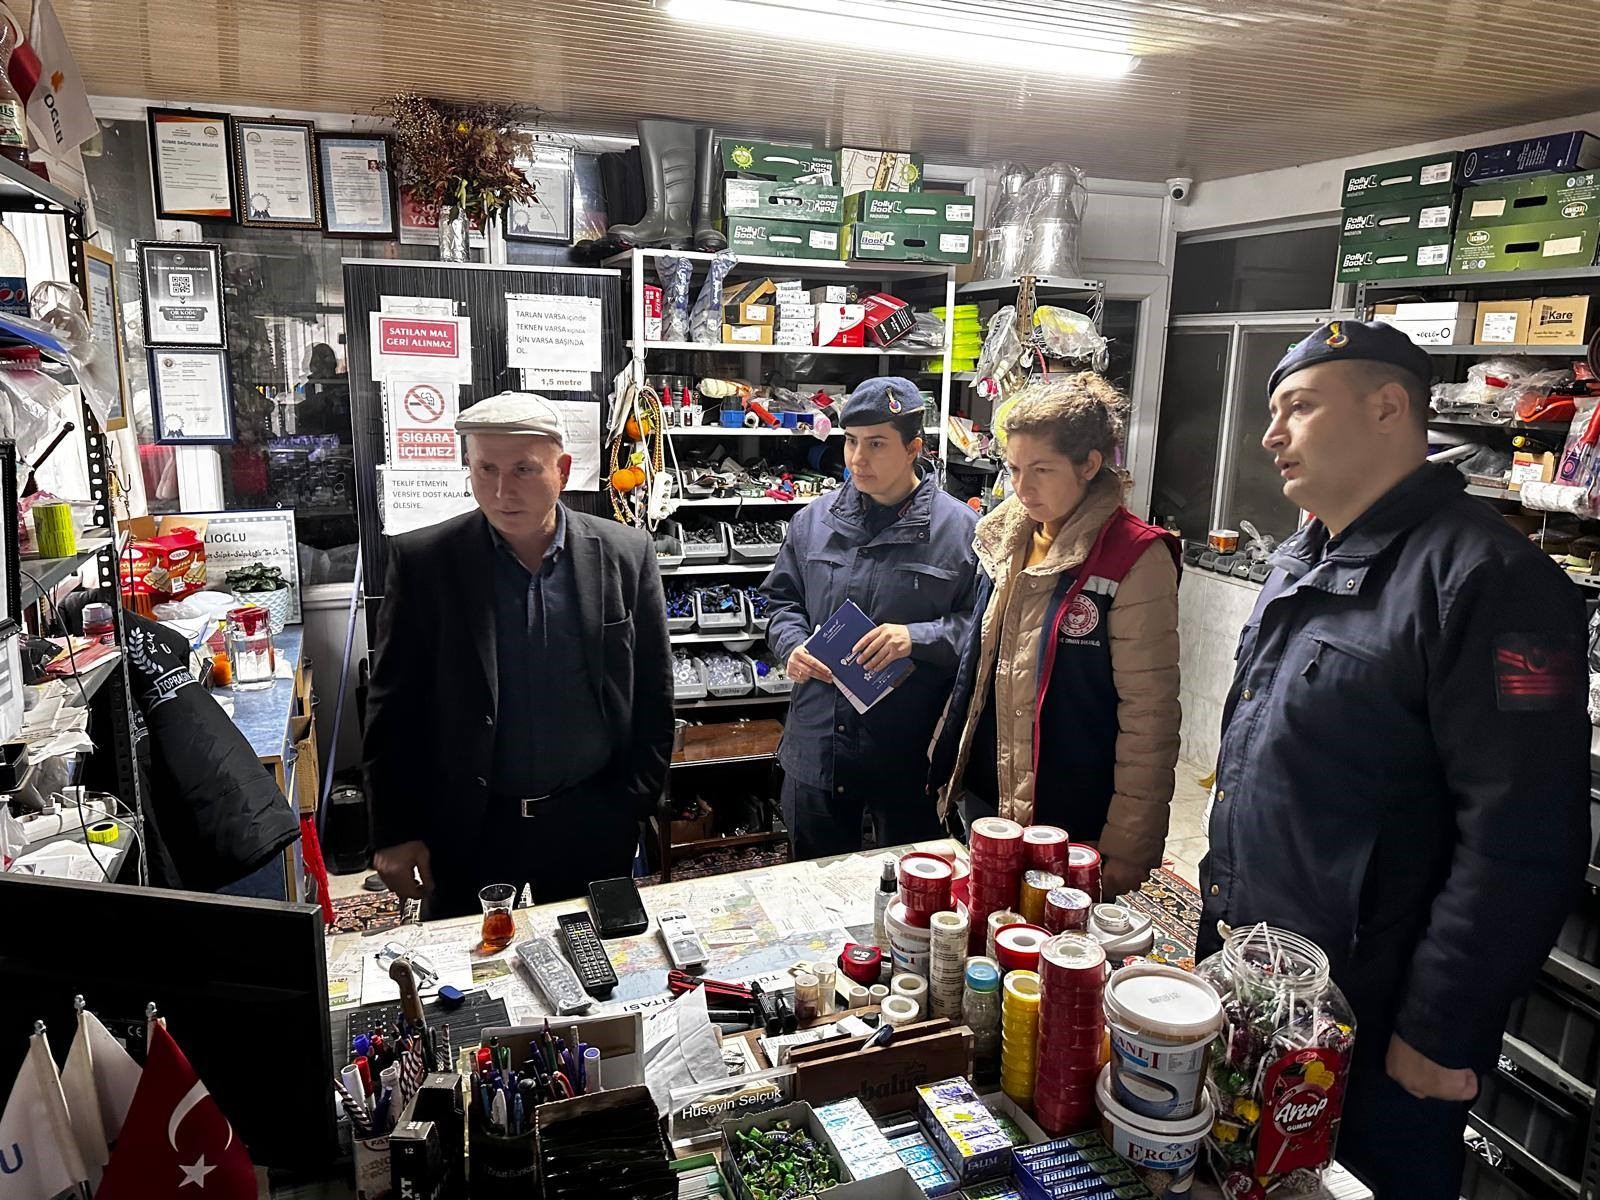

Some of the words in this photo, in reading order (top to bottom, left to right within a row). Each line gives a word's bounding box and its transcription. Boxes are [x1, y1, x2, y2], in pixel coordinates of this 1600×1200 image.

[516, 310, 542, 319] TARLAN
[544, 312, 566, 320] VARSA
[1549, 310, 1573, 320] Kare
[389, 327, 427, 337] SATILAN
[429, 330, 449, 338] MAL
[516, 324, 543, 332] TEKNEN
[544, 325, 567, 333] VARSA
[386, 337, 409, 346] GERİ
[411, 339, 452, 349] ALINMAZ
[531, 337, 554, 345] VARSA
[554, 338, 585, 347] BAŞINDA
[541, 378, 554, 386] 1,5
[401, 431, 451, 443] SİGARA
[400, 445, 455, 460] İÇİLMEZ
[392, 479, 415, 487] TEKLİF
[392, 490, 421, 498] VERSİYE
[682, 1098, 735, 1120] Hüseyin
[739, 1088, 782, 1106] Selçuk
[1032, 1153, 1080, 1171] nanelim
[1043, 1165, 1091, 1183] nanelim
[1054, 1177, 1102, 1196] nanelim
